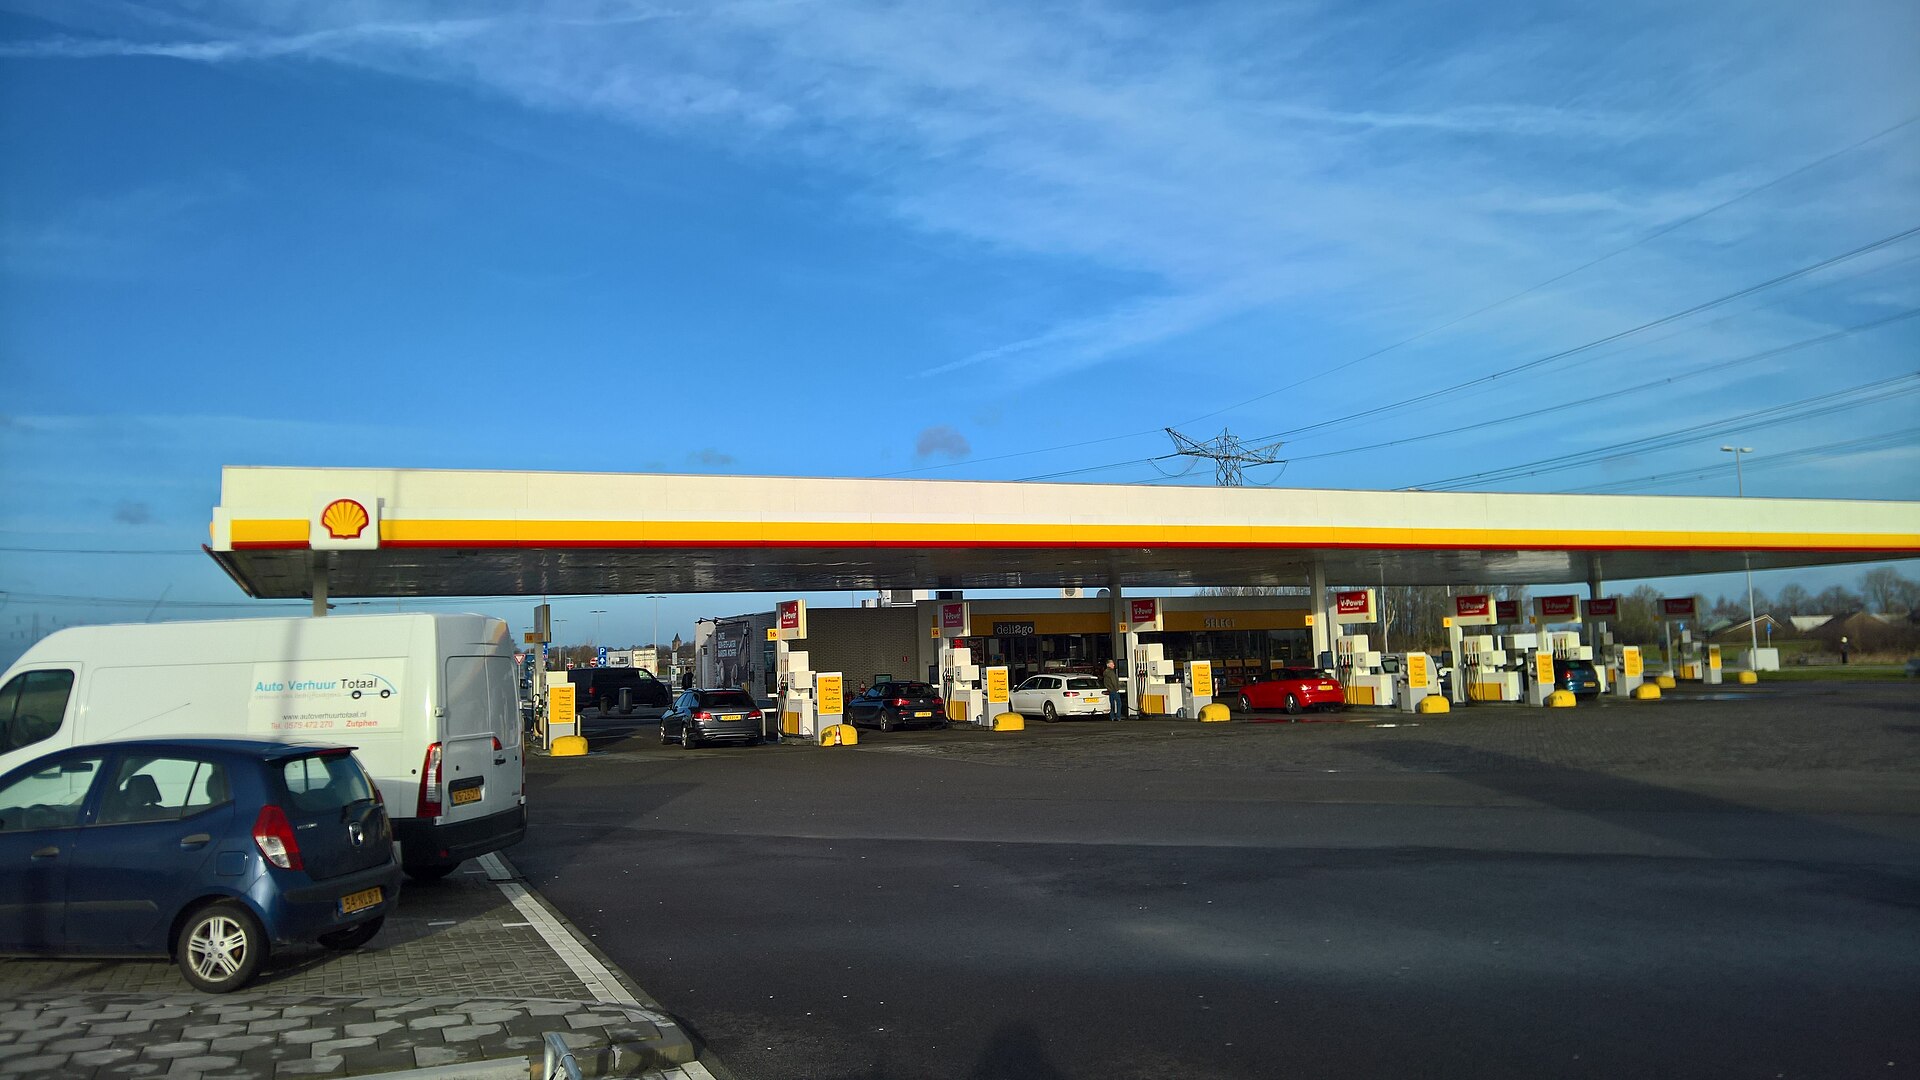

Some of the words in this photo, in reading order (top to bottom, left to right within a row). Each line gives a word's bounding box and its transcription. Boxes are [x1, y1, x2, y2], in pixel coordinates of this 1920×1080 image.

[1341, 599, 1365, 607] V-Power
[1205, 618, 1235, 628] SELECT
[996, 624, 1034, 635] deli2go
[599, 647, 605, 655] P
[255, 682, 284, 692] Auto
[288, 680, 336, 690] Verhuur
[340, 677, 377, 689] Totaal
[346, 720, 378, 728] Zutphen
